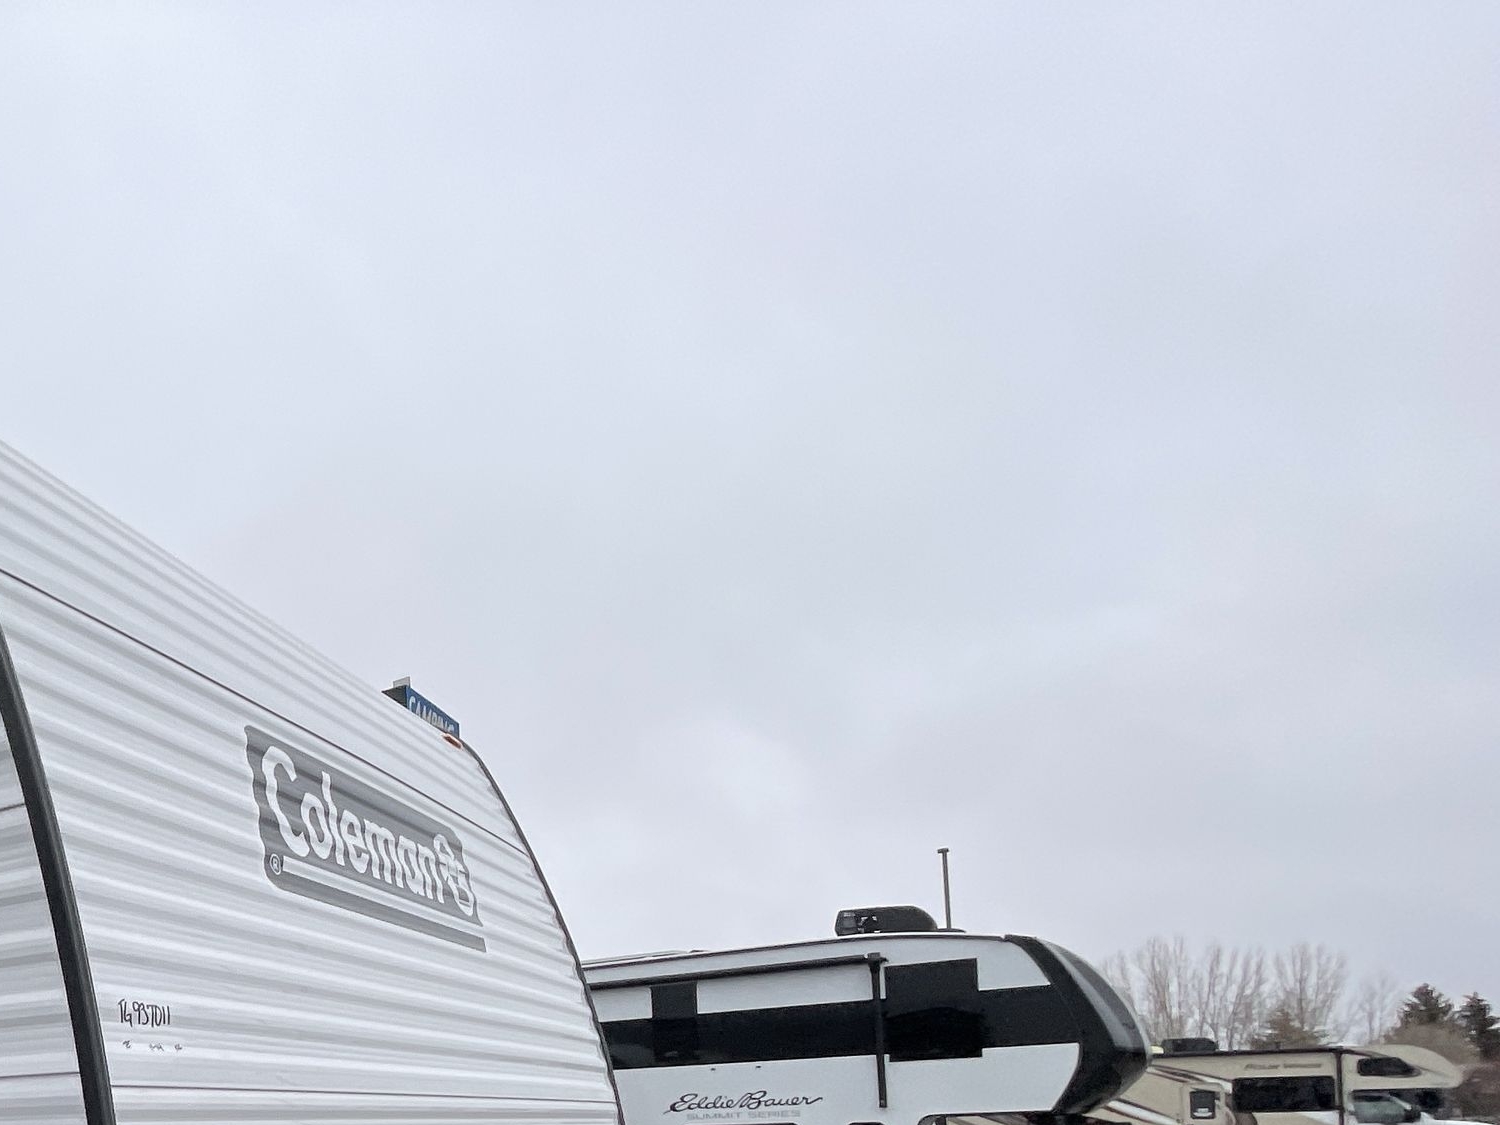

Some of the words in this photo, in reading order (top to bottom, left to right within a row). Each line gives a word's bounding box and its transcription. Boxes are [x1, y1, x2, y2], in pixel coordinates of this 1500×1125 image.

[262, 745, 444, 903] Coleman
[663, 1093, 741, 1115] Eddie
[739, 1090, 823, 1110] Bauer
[686, 1112, 743, 1121] SUMMIT
[747, 1110, 802, 1120] SERIES
